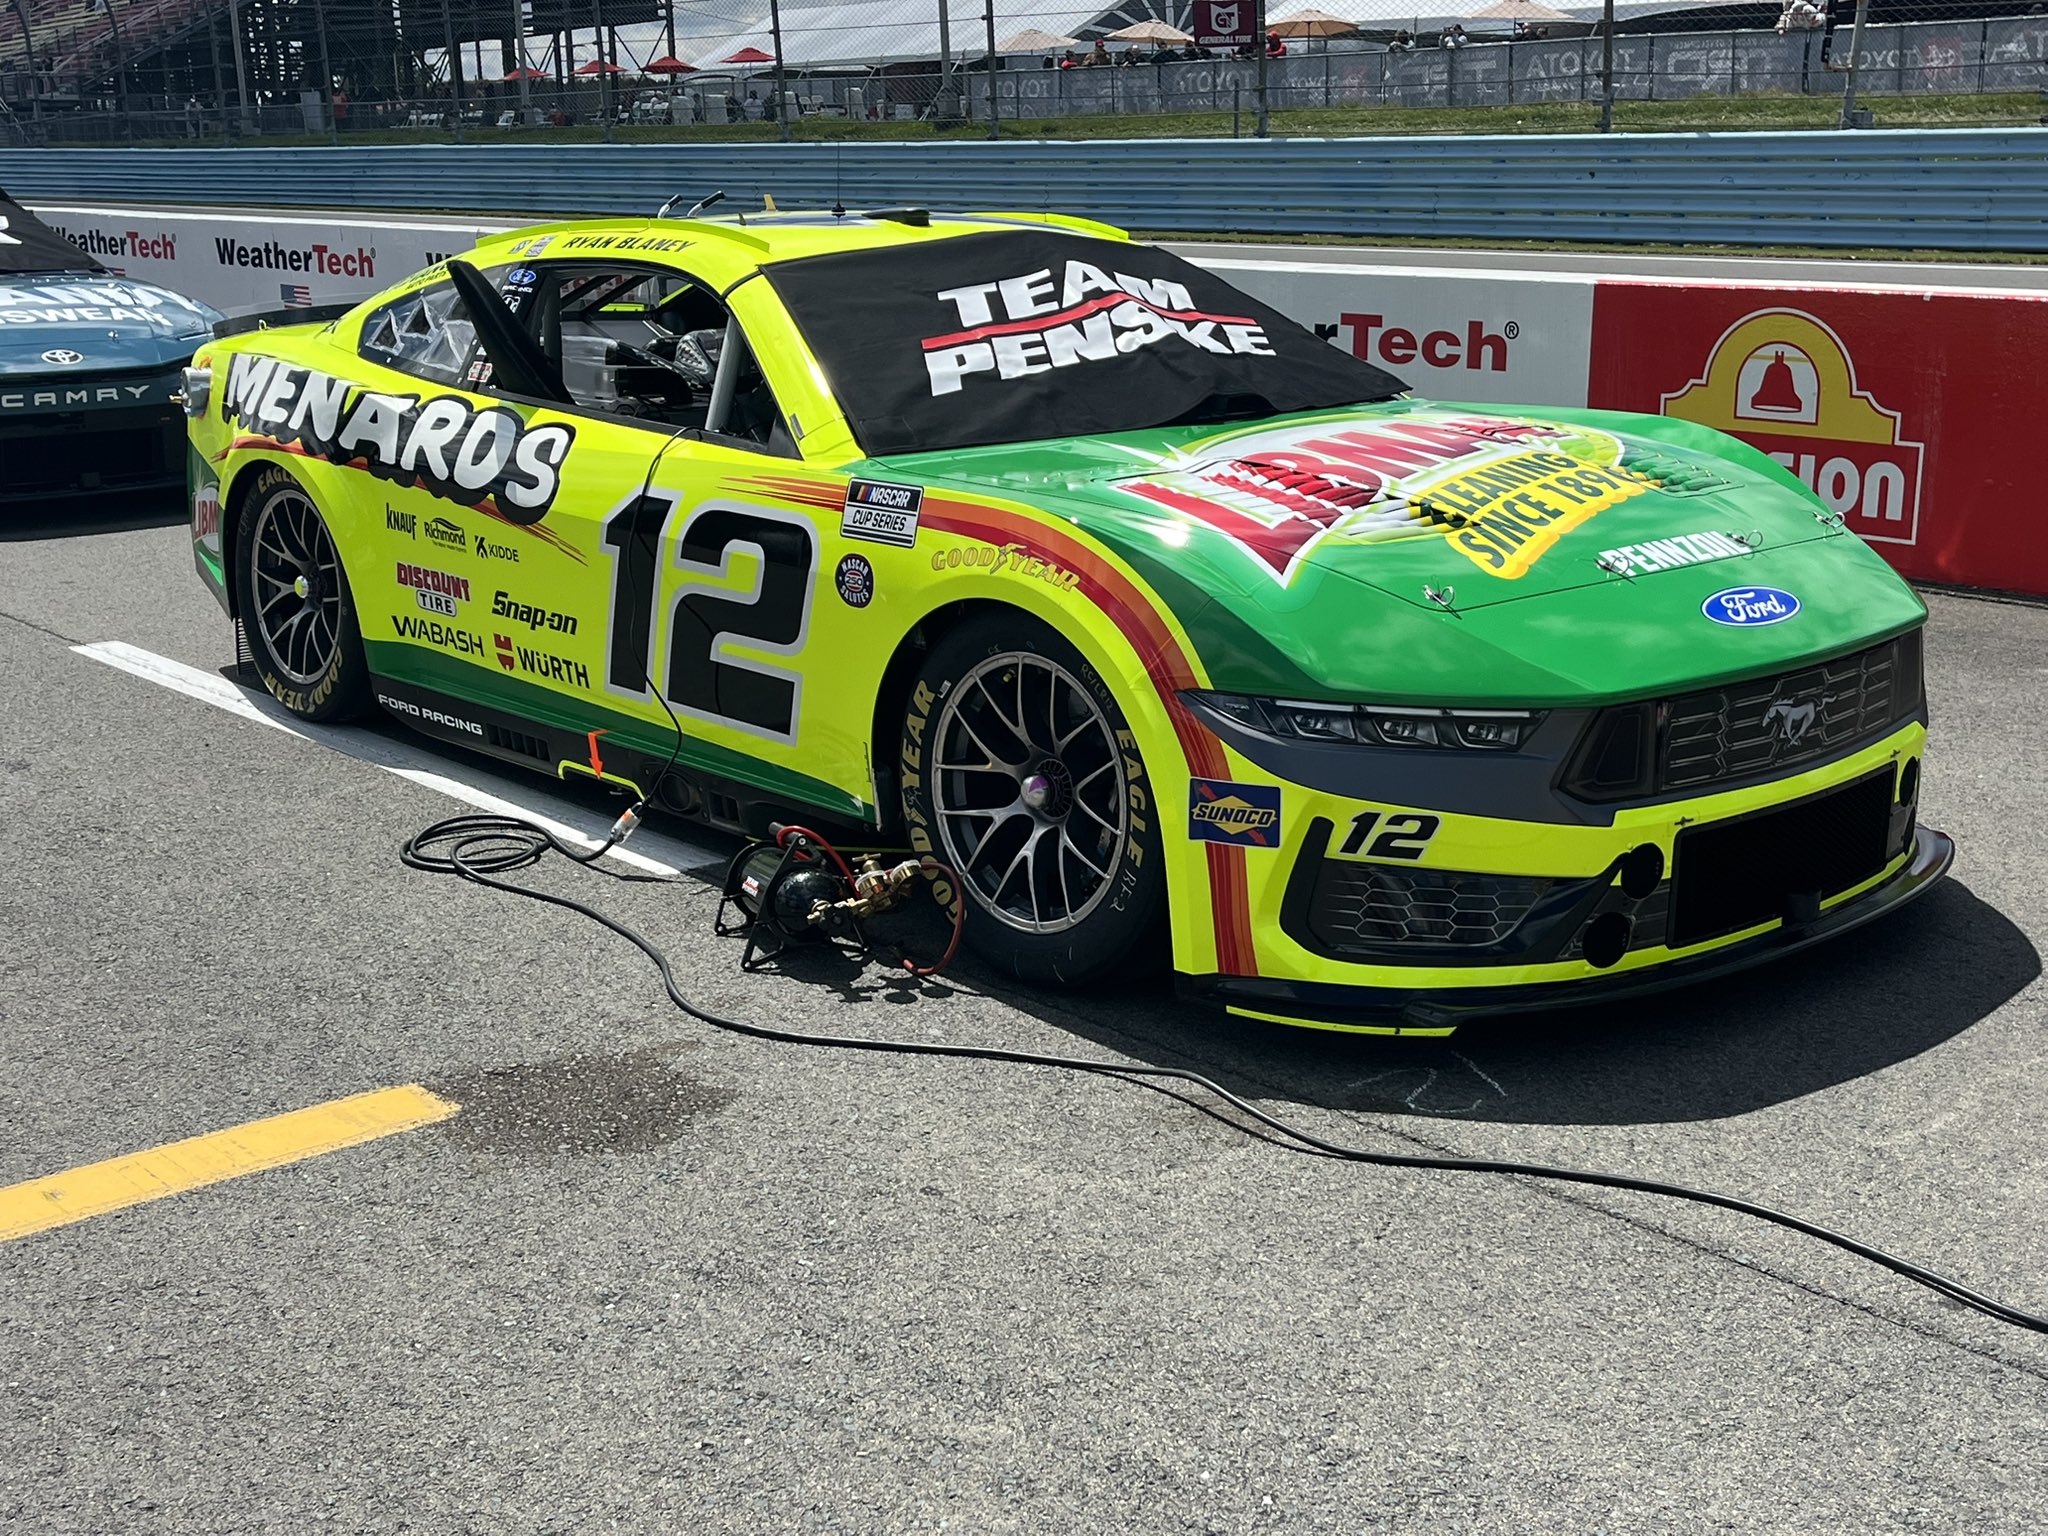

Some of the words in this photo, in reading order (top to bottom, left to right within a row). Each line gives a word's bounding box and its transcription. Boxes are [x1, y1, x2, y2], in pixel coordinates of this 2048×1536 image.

[1199, 36, 1234, 44] GENERAL
[1235, 35, 1252, 43] TIRE
[50, 226, 176, 260] eatherTech
[563, 236, 617, 249] RYAN
[614, 236, 697, 253] BLANEY
[937, 260, 1197, 328] TEAM
[0, 306, 173, 328] SWEAR
[924, 301, 1277, 397] PENSKE
[1, 384, 150, 408] CAMRY
[225, 352, 573, 510] MENARDS
[868, 487, 911, 508] NASCAR
[386, 502, 417, 541] KNAUF
[424, 521, 466, 547] Richmond
[852, 509, 873, 526] CUP
[872, 512, 907, 532] SERIES
[1458, 492, 1565, 569] SINCE
[488, 544, 520, 563] KIDDE
[841, 559, 869, 576] NASCAR
[1598, 530, 1753, 577] PENNZOIL
[396, 562, 471, 602] DISCOUNT
[419, 592, 453, 614] TIRE
[491, 590, 578, 636] Snap-on
[599, 486, 820, 748] 12
[1720, 591, 1786, 622] Ford
[391, 615, 485, 657] WABASH
[516, 645, 591, 689] WÜRTH
[378, 694, 420, 717] FORD
[422, 708, 483, 736] RACING
[1115, 729, 1147, 868] EAGLE
[1196, 804, 1275, 826] SUNOCO
[1339, 811, 1442, 861] 12
